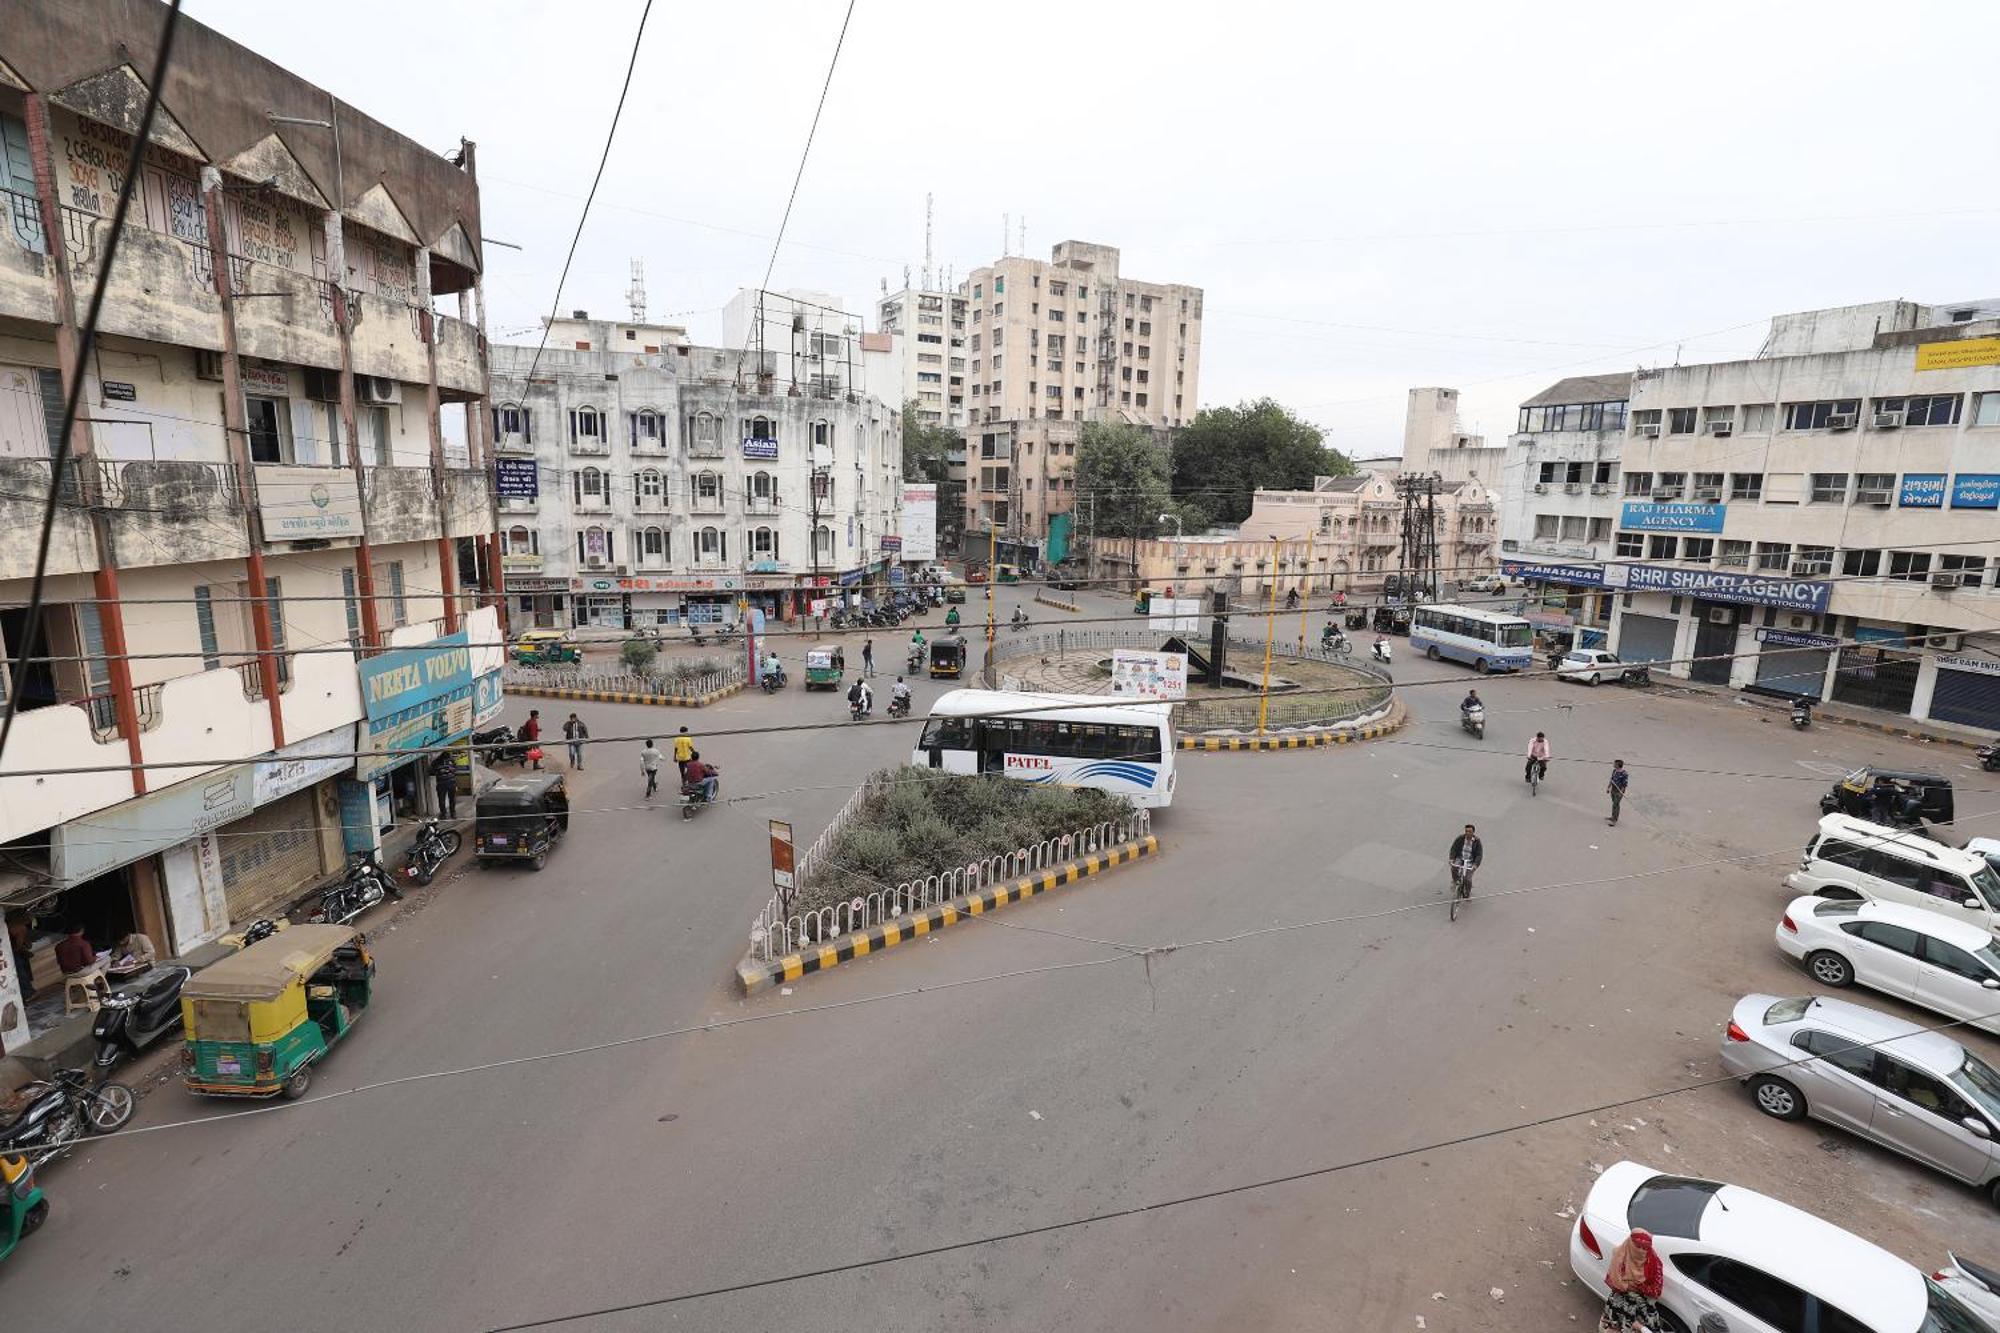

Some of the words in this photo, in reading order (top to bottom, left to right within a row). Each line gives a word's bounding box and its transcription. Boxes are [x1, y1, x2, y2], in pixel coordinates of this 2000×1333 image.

[745, 439, 777, 449] Asian
[1629, 504, 1653, 513] RAJ
[1656, 505, 1716, 515] PHARMA
[1642, 516, 1698, 526] AGENCY
[1630, 567, 1668, 585] SHRI
[1671, 571, 1736, 592] SHAKTI
[1737, 578, 1824, 603] AGENCY
[1700, 591, 1761, 603] DISTRIBUTORS
[1936, 655, 1958, 665] SHREE
[1959, 658, 1979, 668] RAM
[368, 662, 422, 704] NEETA
[425, 648, 468, 684] VOLVO
[1007, 756, 1053, 770] PATEL
